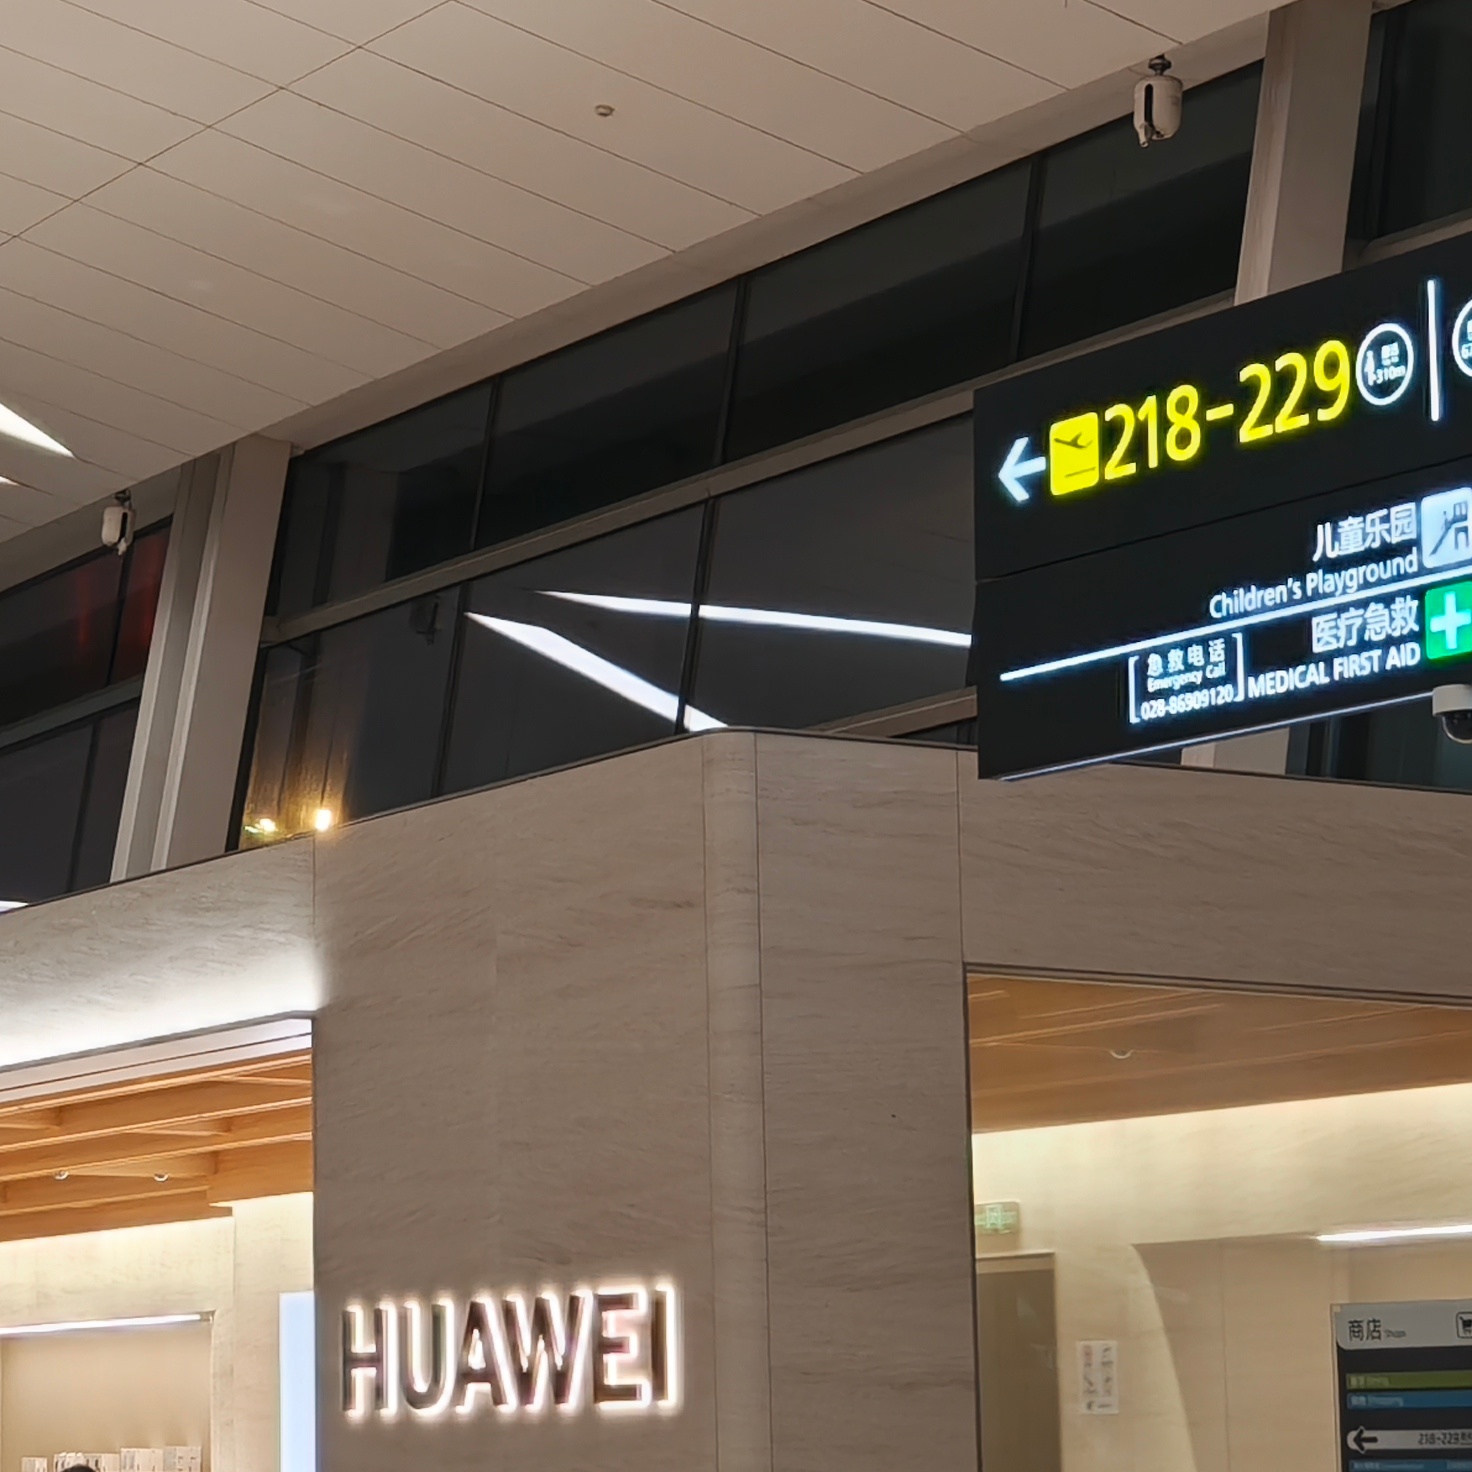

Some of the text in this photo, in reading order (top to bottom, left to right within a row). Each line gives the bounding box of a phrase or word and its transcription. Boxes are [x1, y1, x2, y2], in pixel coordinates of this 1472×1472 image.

[1103, 339, 1351, 480] 218-229
[1312, 501, 1418, 562] 儿童乐园
[1208, 546, 1419, 620] Children's Playground
[1311, 594, 1420, 654] 医疗急救
[1146, 637, 1226, 678] 急救电话
[1146, 660, 1227, 694] Emergency Call
[1247, 642, 1422, 699] MEDICAL FIRST AID
[341, 1285, 680, 1418] HUAWEI
[1348, 1318, 1382, 1342] 商店
